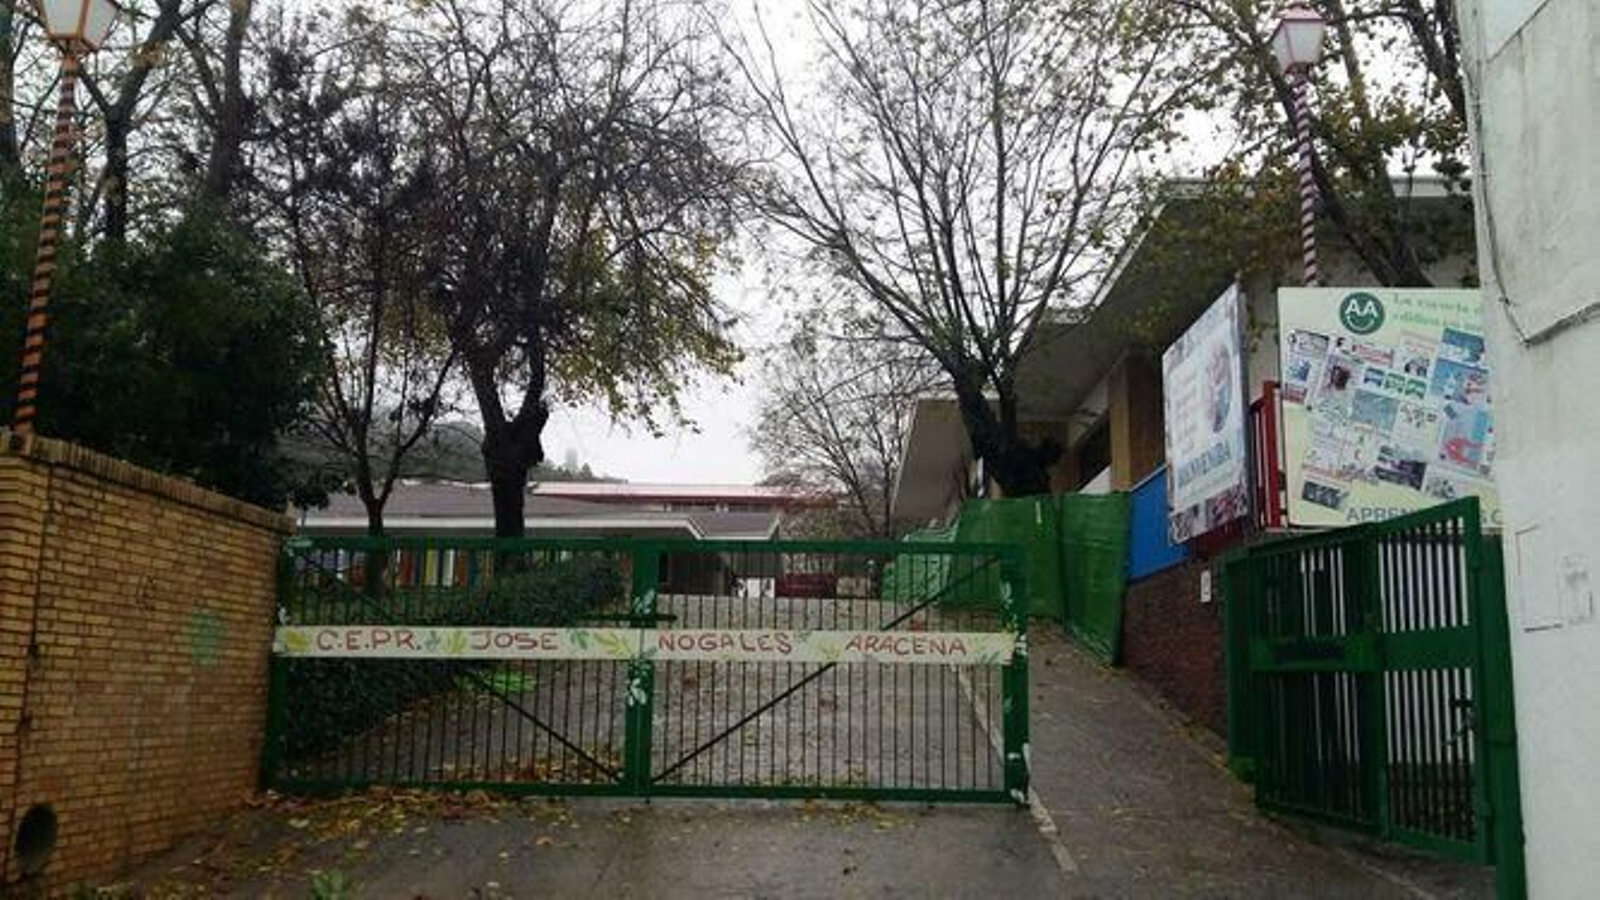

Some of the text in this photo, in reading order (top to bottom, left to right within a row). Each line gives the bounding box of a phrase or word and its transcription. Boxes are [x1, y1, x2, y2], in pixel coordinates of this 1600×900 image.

[470, 630, 559, 651] JOSE
[658, 632, 792, 655] NOGALES
[845, 634, 967, 656] ARACENA
